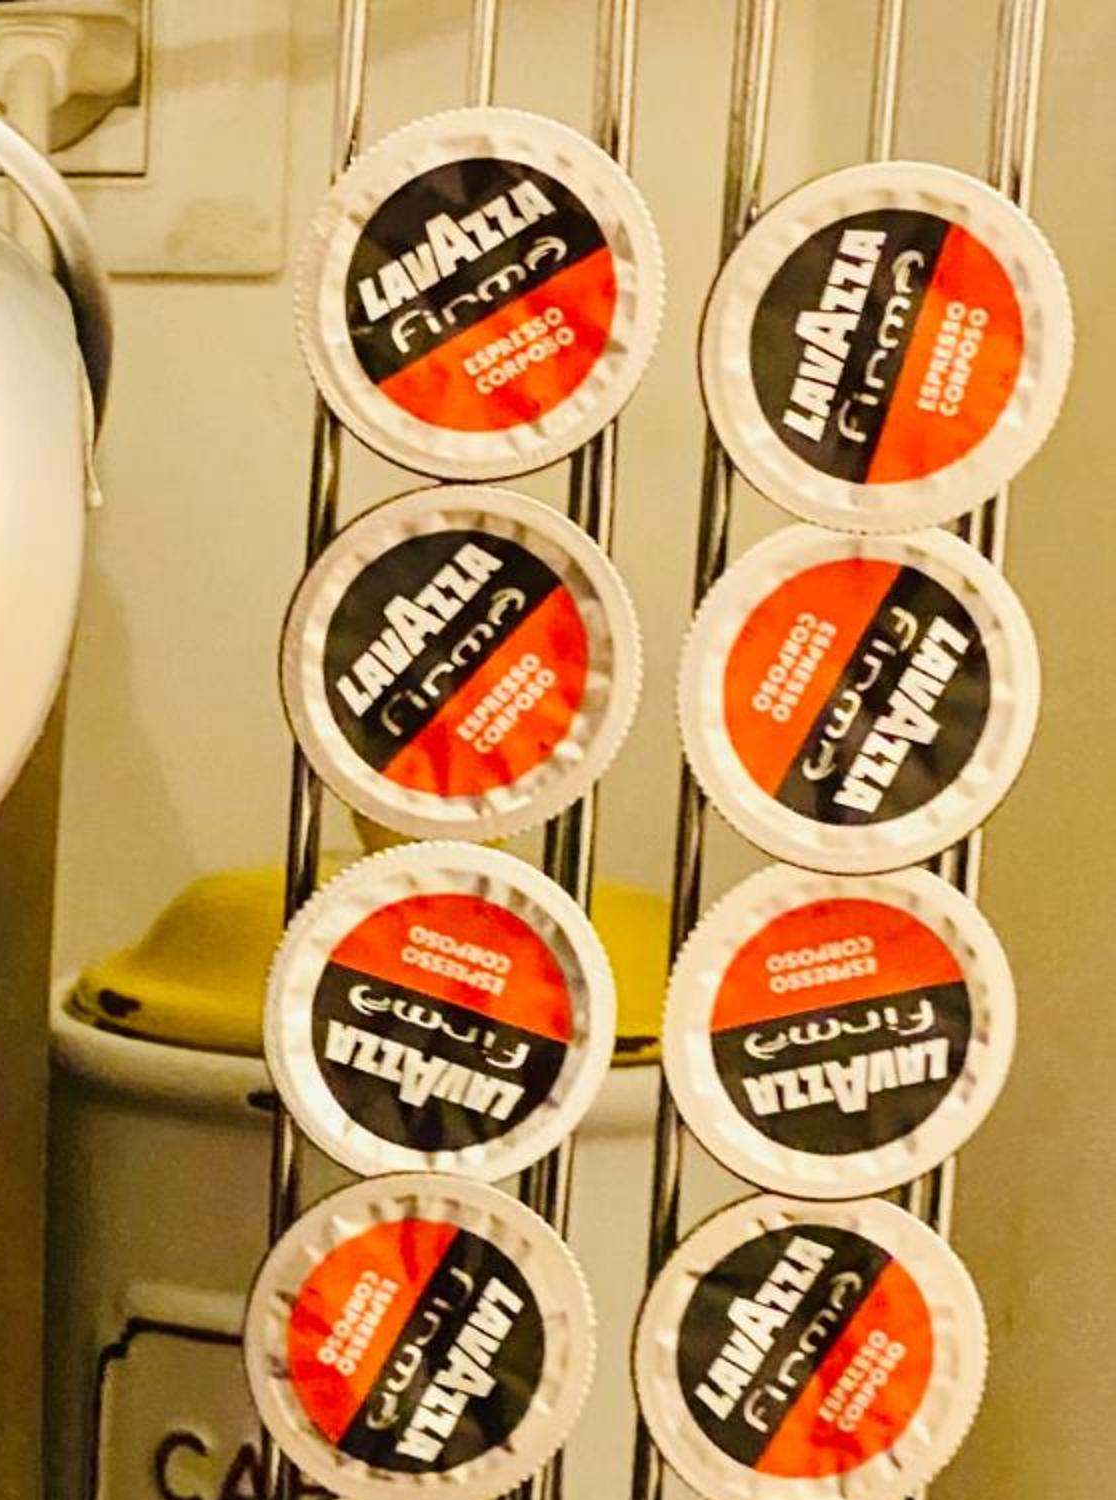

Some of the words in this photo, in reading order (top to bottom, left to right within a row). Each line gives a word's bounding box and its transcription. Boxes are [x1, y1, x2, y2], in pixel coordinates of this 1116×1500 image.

[358, 180, 556, 322] LAVAZZA
[463, 306, 563, 377] ESPRESSO
[475, 328, 575, 395] CORPOSO
[783, 229, 886, 443] LAVAZZA
[336, 543, 504, 718] LAVAZZA
[833, 616, 969, 813] LAVAZZA
[765, 936, 874, 973] CORPOSO
[770, 956, 878, 994] ESPRESSO
[325, 1019, 525, 1121] LAVAZZA
[742, 1038, 949, 1116] LAVAZZA
[395, 1277, 525, 1462] LAVAZZA
[694, 1235, 835, 1421] LAVAZZA
